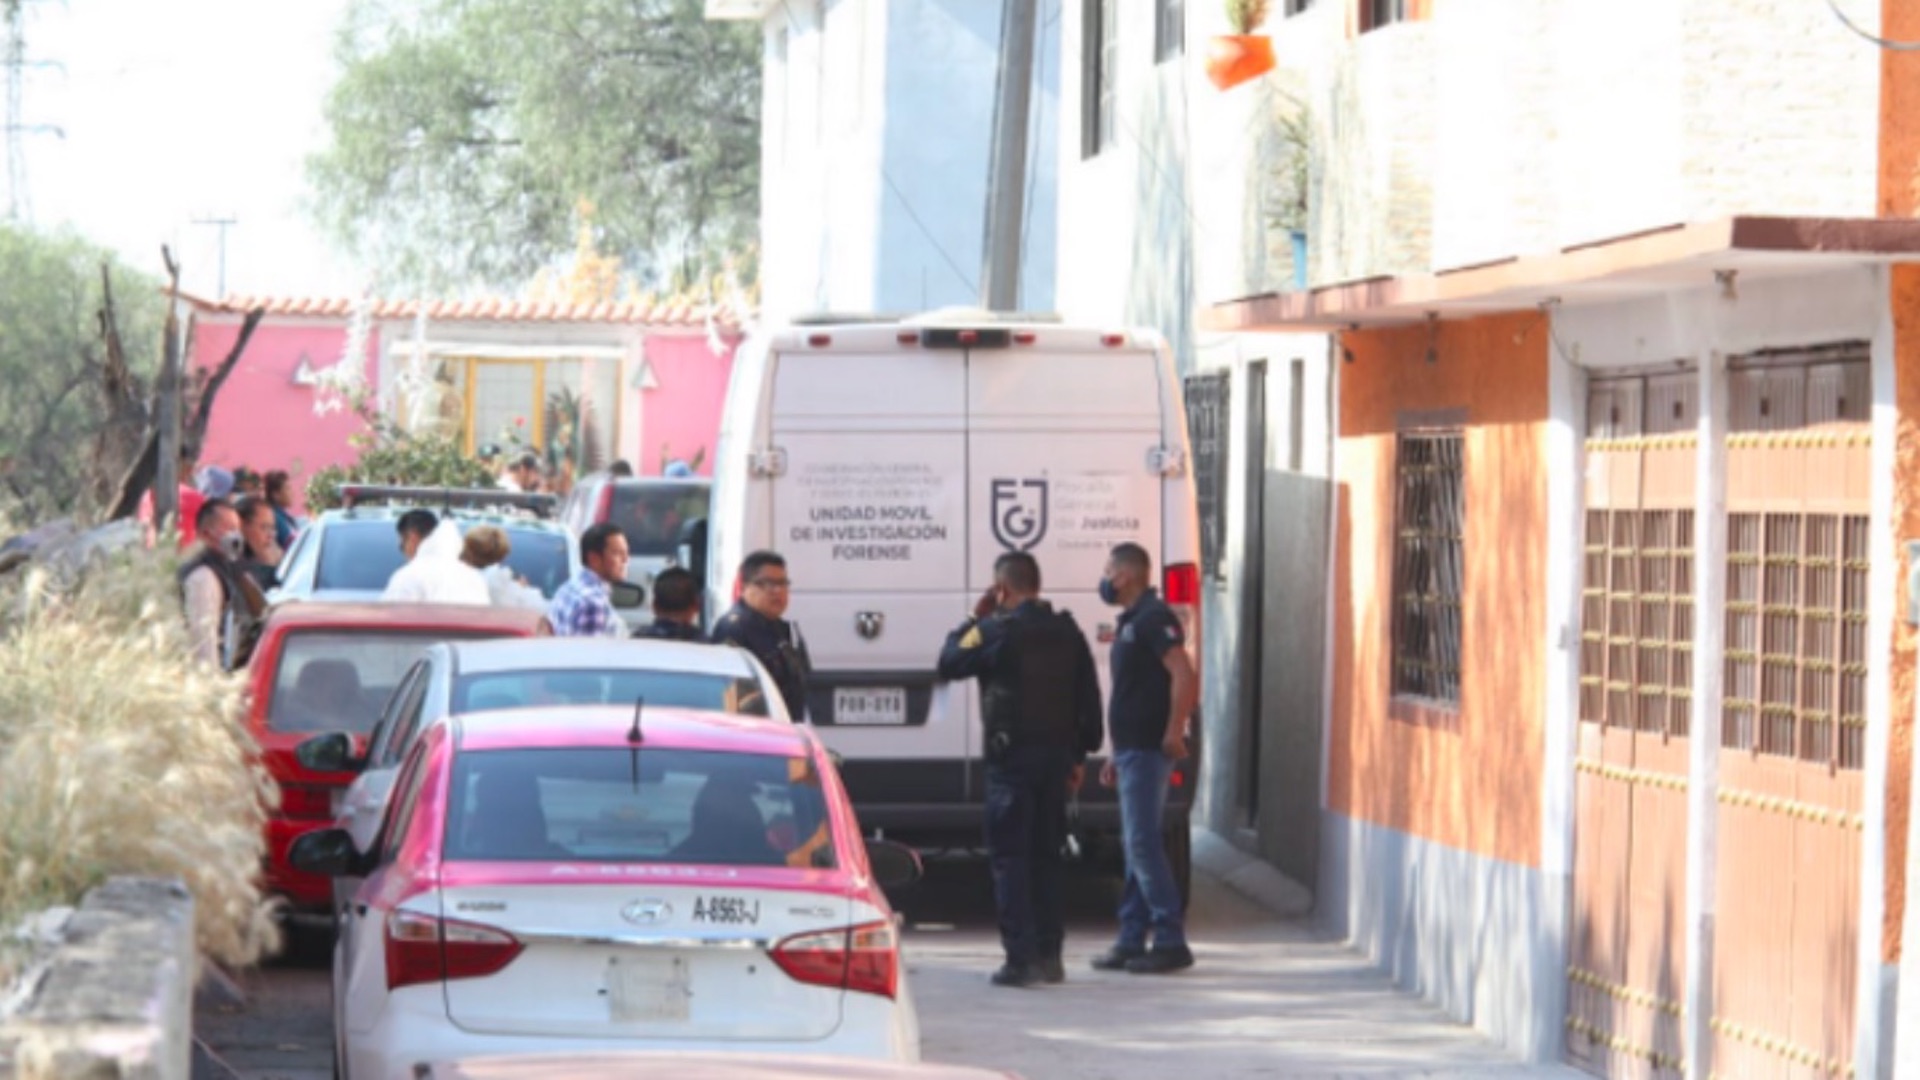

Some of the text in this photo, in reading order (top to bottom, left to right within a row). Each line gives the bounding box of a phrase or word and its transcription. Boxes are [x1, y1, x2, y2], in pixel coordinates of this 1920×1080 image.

[809, 505, 876, 521] UNIDAD
[1081, 516, 1140, 530] Justicia
[791, 527, 812, 541] DE
[833, 544, 911, 561] FORENSE
